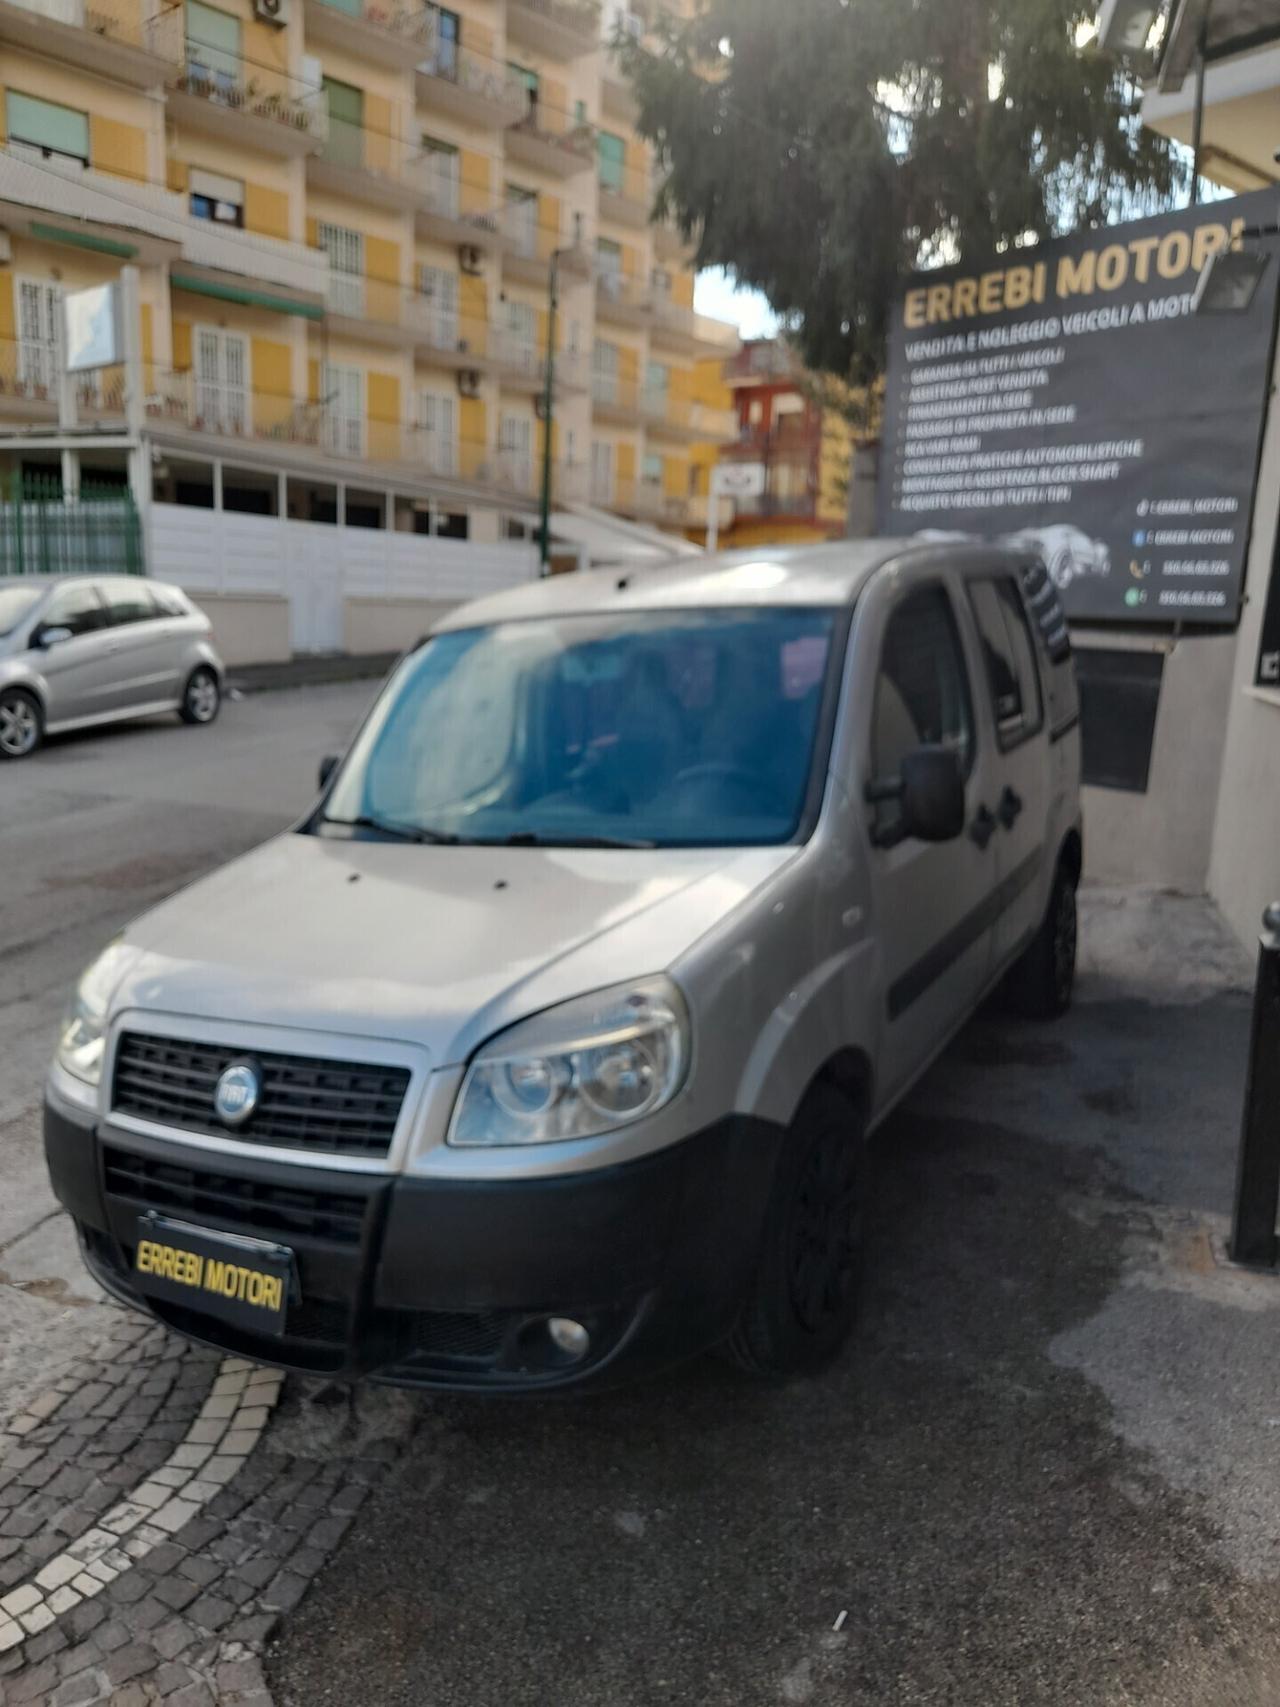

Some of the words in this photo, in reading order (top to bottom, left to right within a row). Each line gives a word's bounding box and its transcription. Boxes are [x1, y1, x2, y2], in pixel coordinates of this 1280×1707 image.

[904, 262, 1047, 329] ERREBI
[904, 335, 967, 363] VENDITA
[967, 333, 978, 352] E
[1061, 306, 1129, 337] VEICOLI
[1129, 302, 1145, 325] A
[136, 1240, 202, 1289] ERREBI
[204, 1258, 284, 1312] MOTORI
